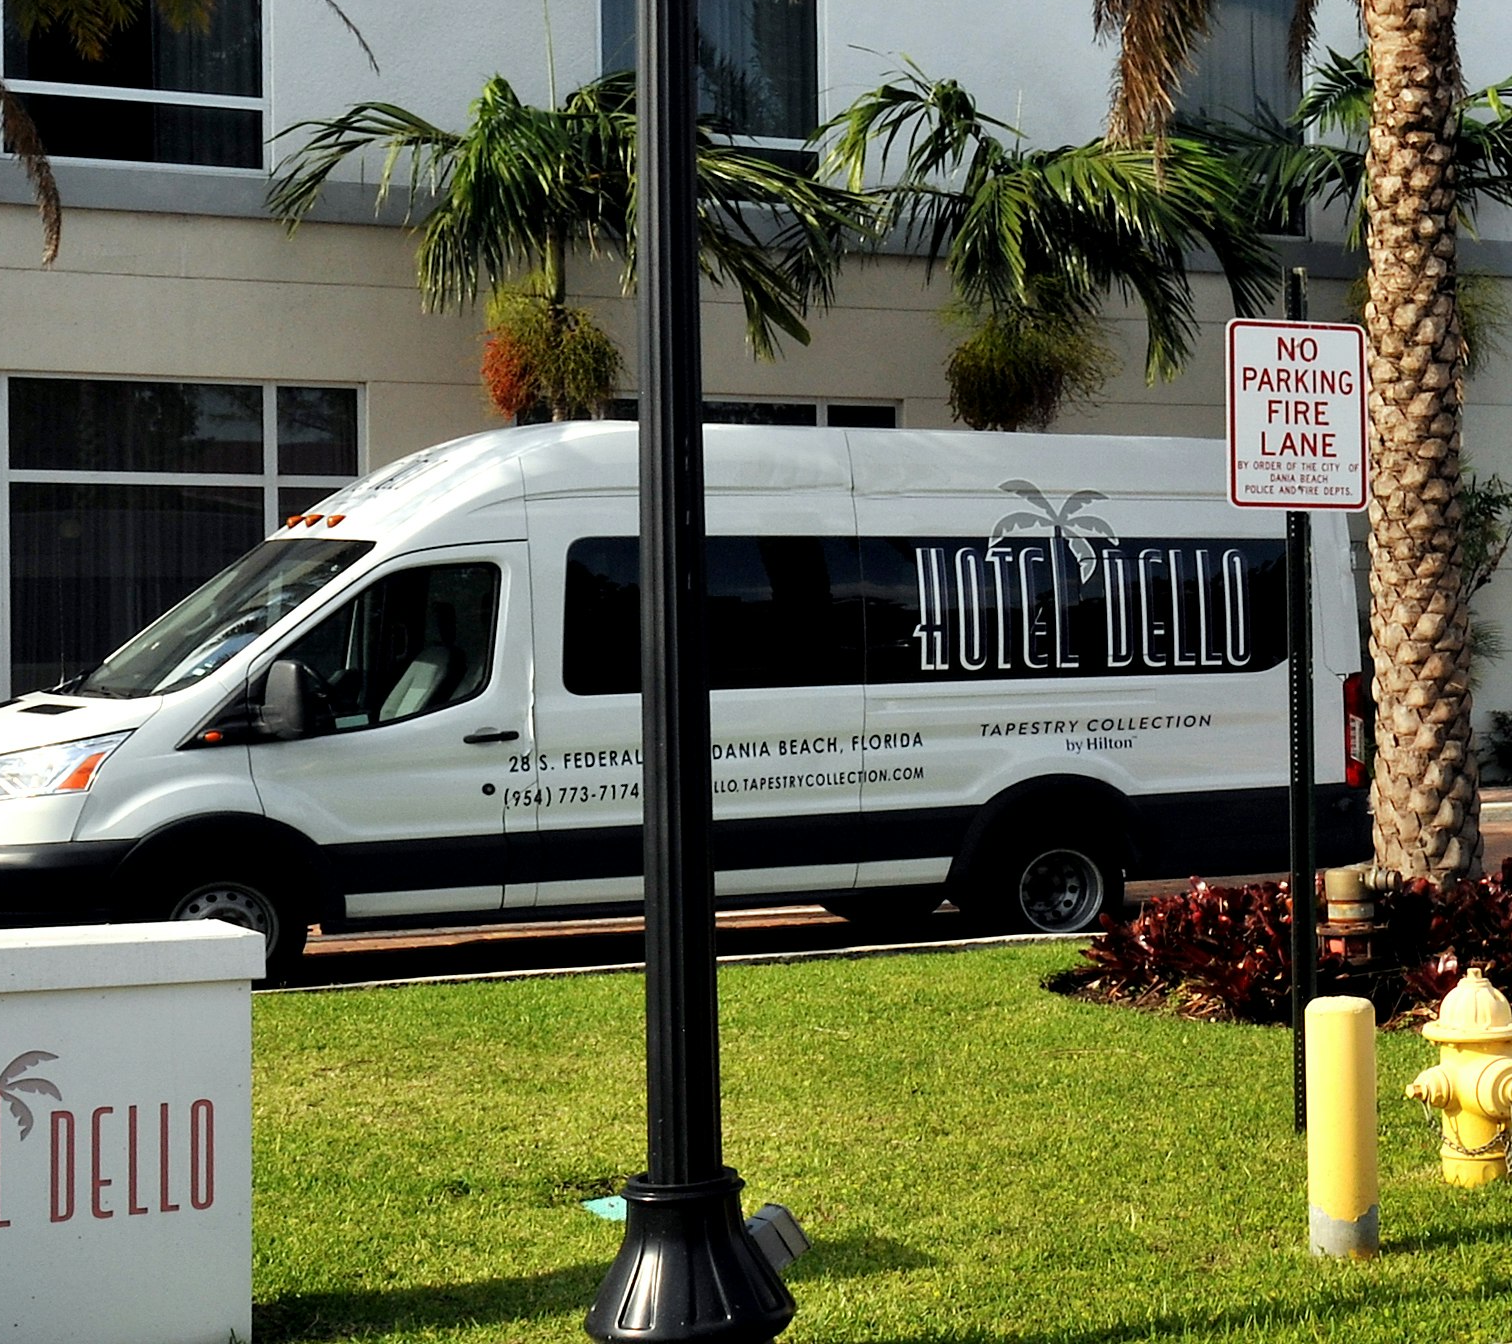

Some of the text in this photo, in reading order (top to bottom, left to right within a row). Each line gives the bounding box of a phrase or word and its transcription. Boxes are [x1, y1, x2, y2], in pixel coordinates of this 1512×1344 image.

[1277, 336, 1318, 363] NO
[1242, 367, 1354, 396] PARKING
[1268, 399, 1330, 426] FIRE
[1261, 431, 1337, 458] LANE
[1238, 461, 1360, 473] BY ORDER OF THE CITY OF
[1270, 473, 1328, 484] DANIA BEACH
[1244, 485, 1353, 497] POLICE AND FIRE DEPTS.
[913, 526, 1251, 670] HOTEL DELLO
[980, 714, 1213, 737] TAPESTRY COLLECTION
[508, 731, 924, 773] 28 S. FEDERAL DANIA BEACH, FLORIDA
[1065, 738, 1083, 755] by
[504, 766, 925, 810] (954) 773-7174 LLO.TAPESTRYCOLLECTION.COM
[49, 1098, 215, 1224] DELLO
